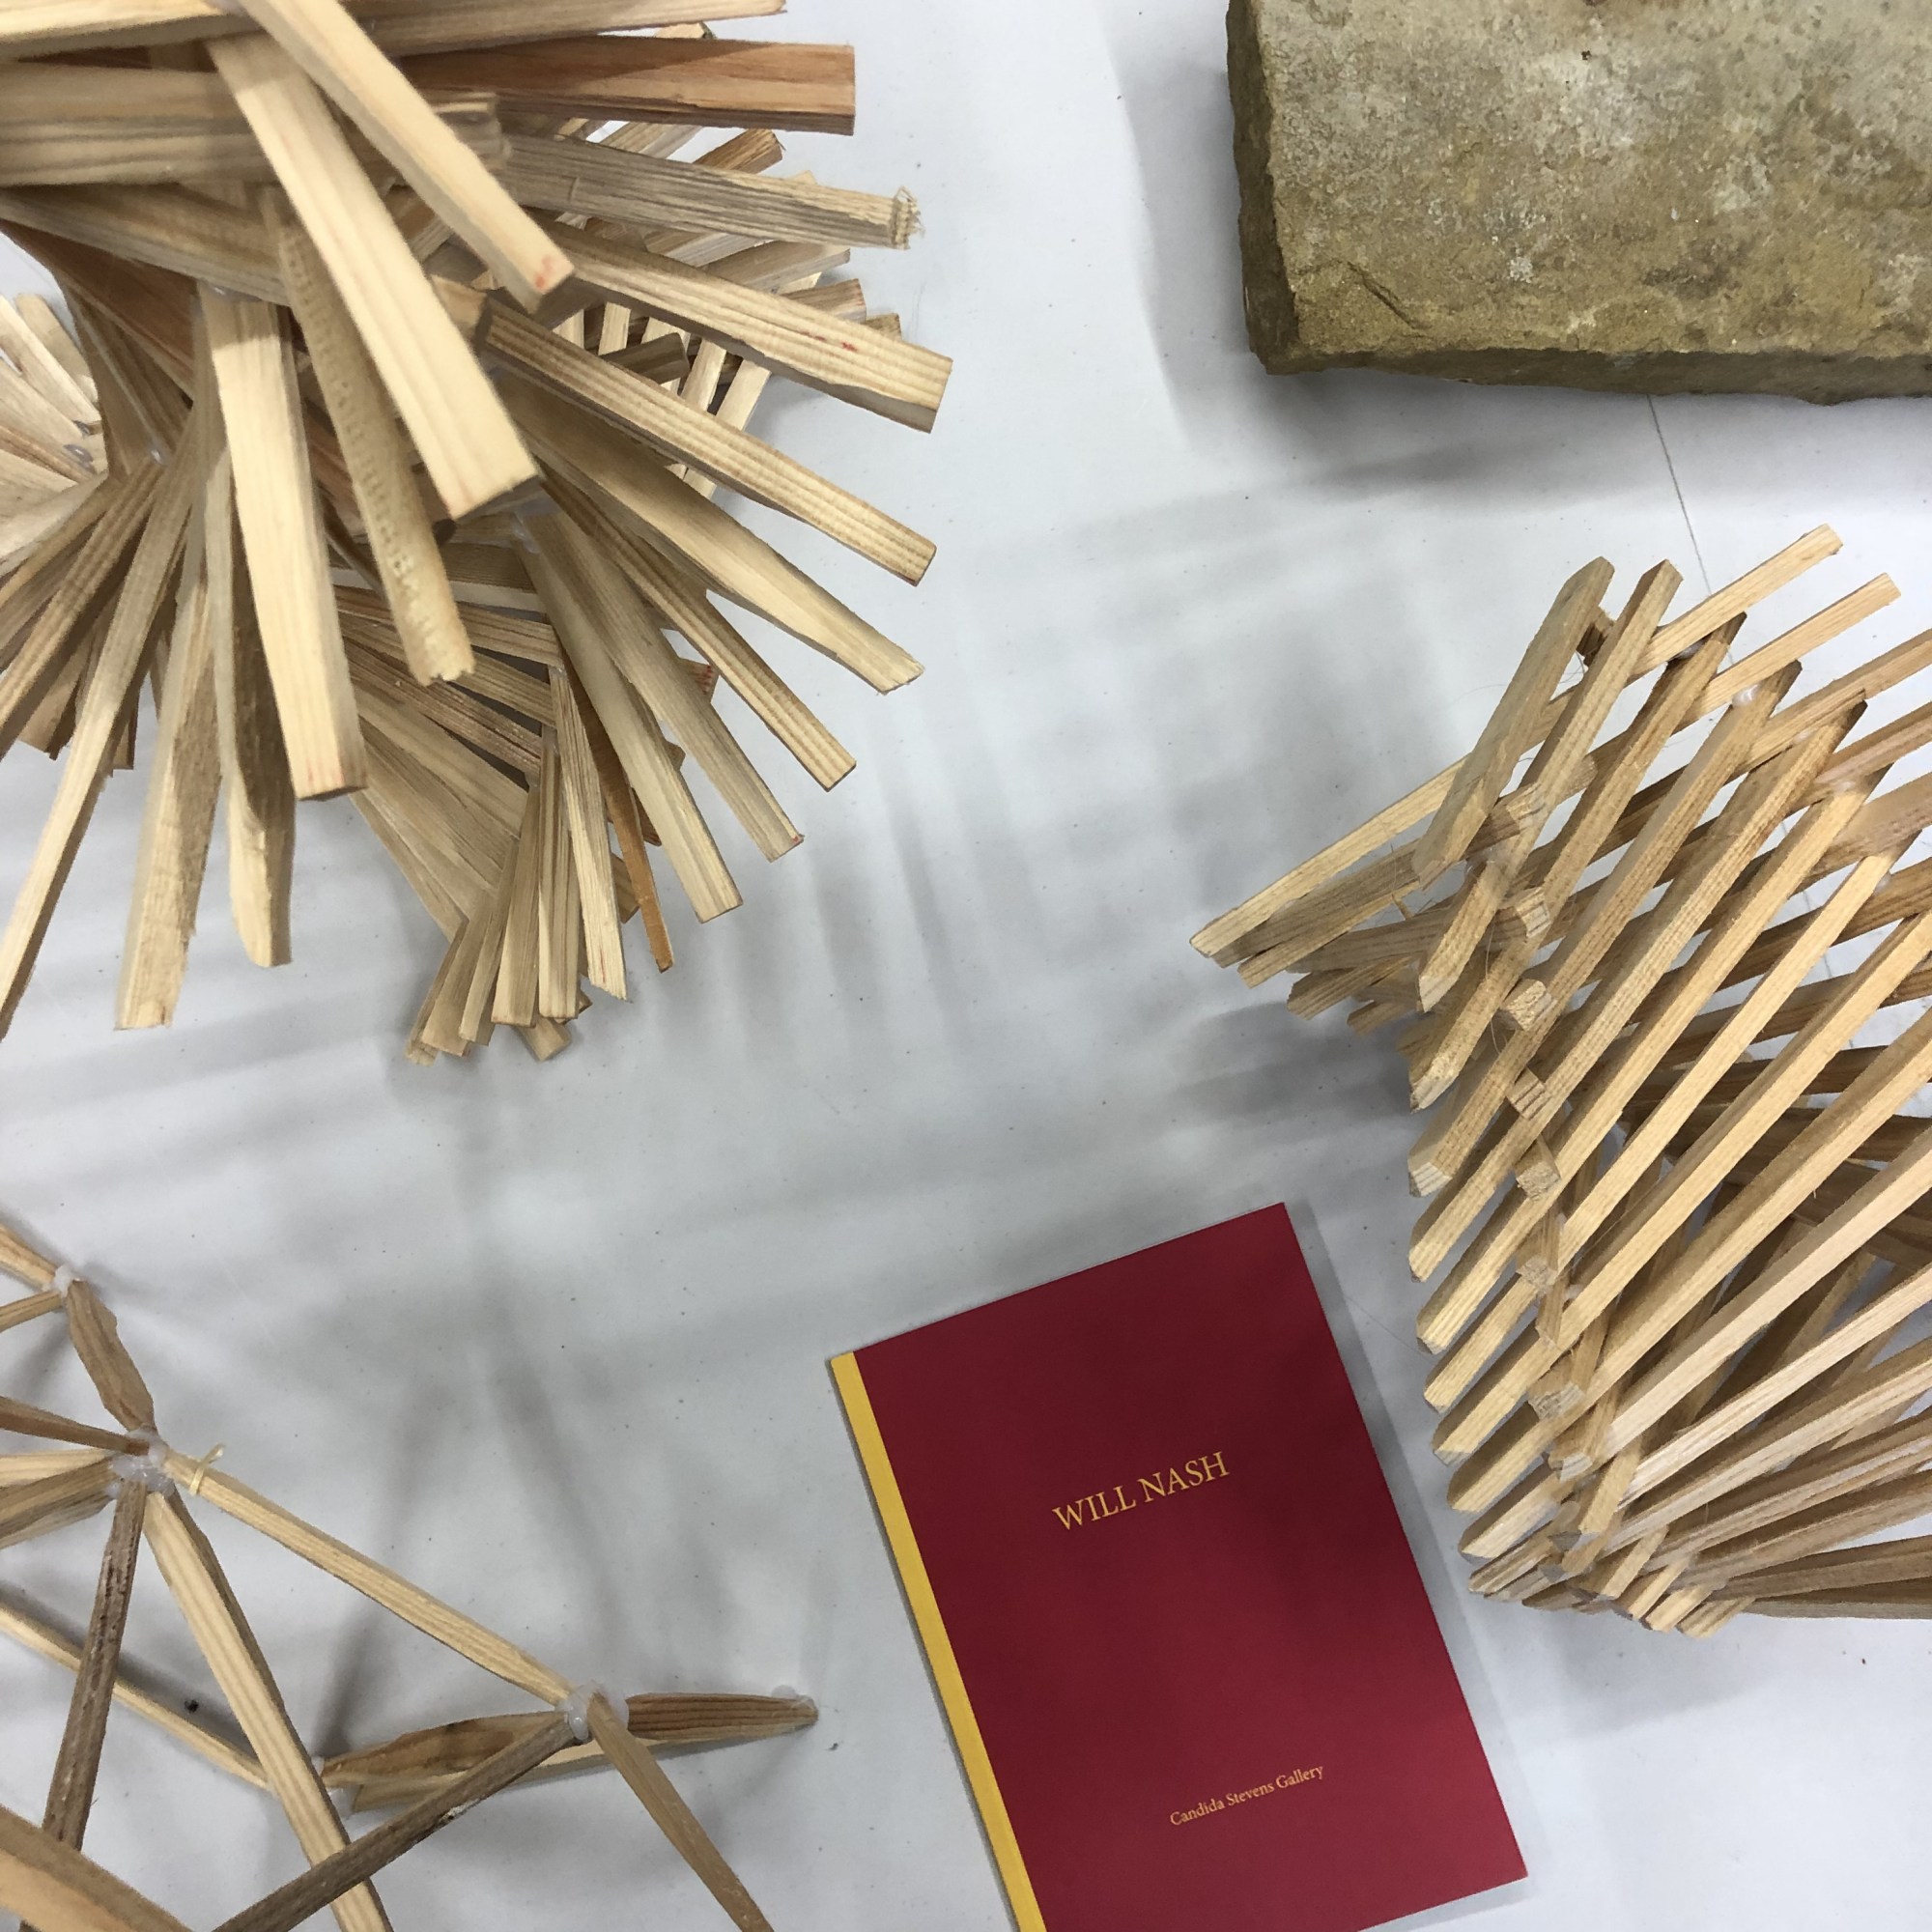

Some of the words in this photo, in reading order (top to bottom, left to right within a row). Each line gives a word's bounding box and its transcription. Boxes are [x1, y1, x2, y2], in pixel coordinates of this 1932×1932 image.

[1051, 1485, 1137, 1531] WILL
[1137, 1451, 1230, 1503] NASH
[1170, 1798, 1226, 1826] Candida
[1225, 1782, 1275, 1807] Stevens
[1275, 1766, 1323, 1789] Gallery
